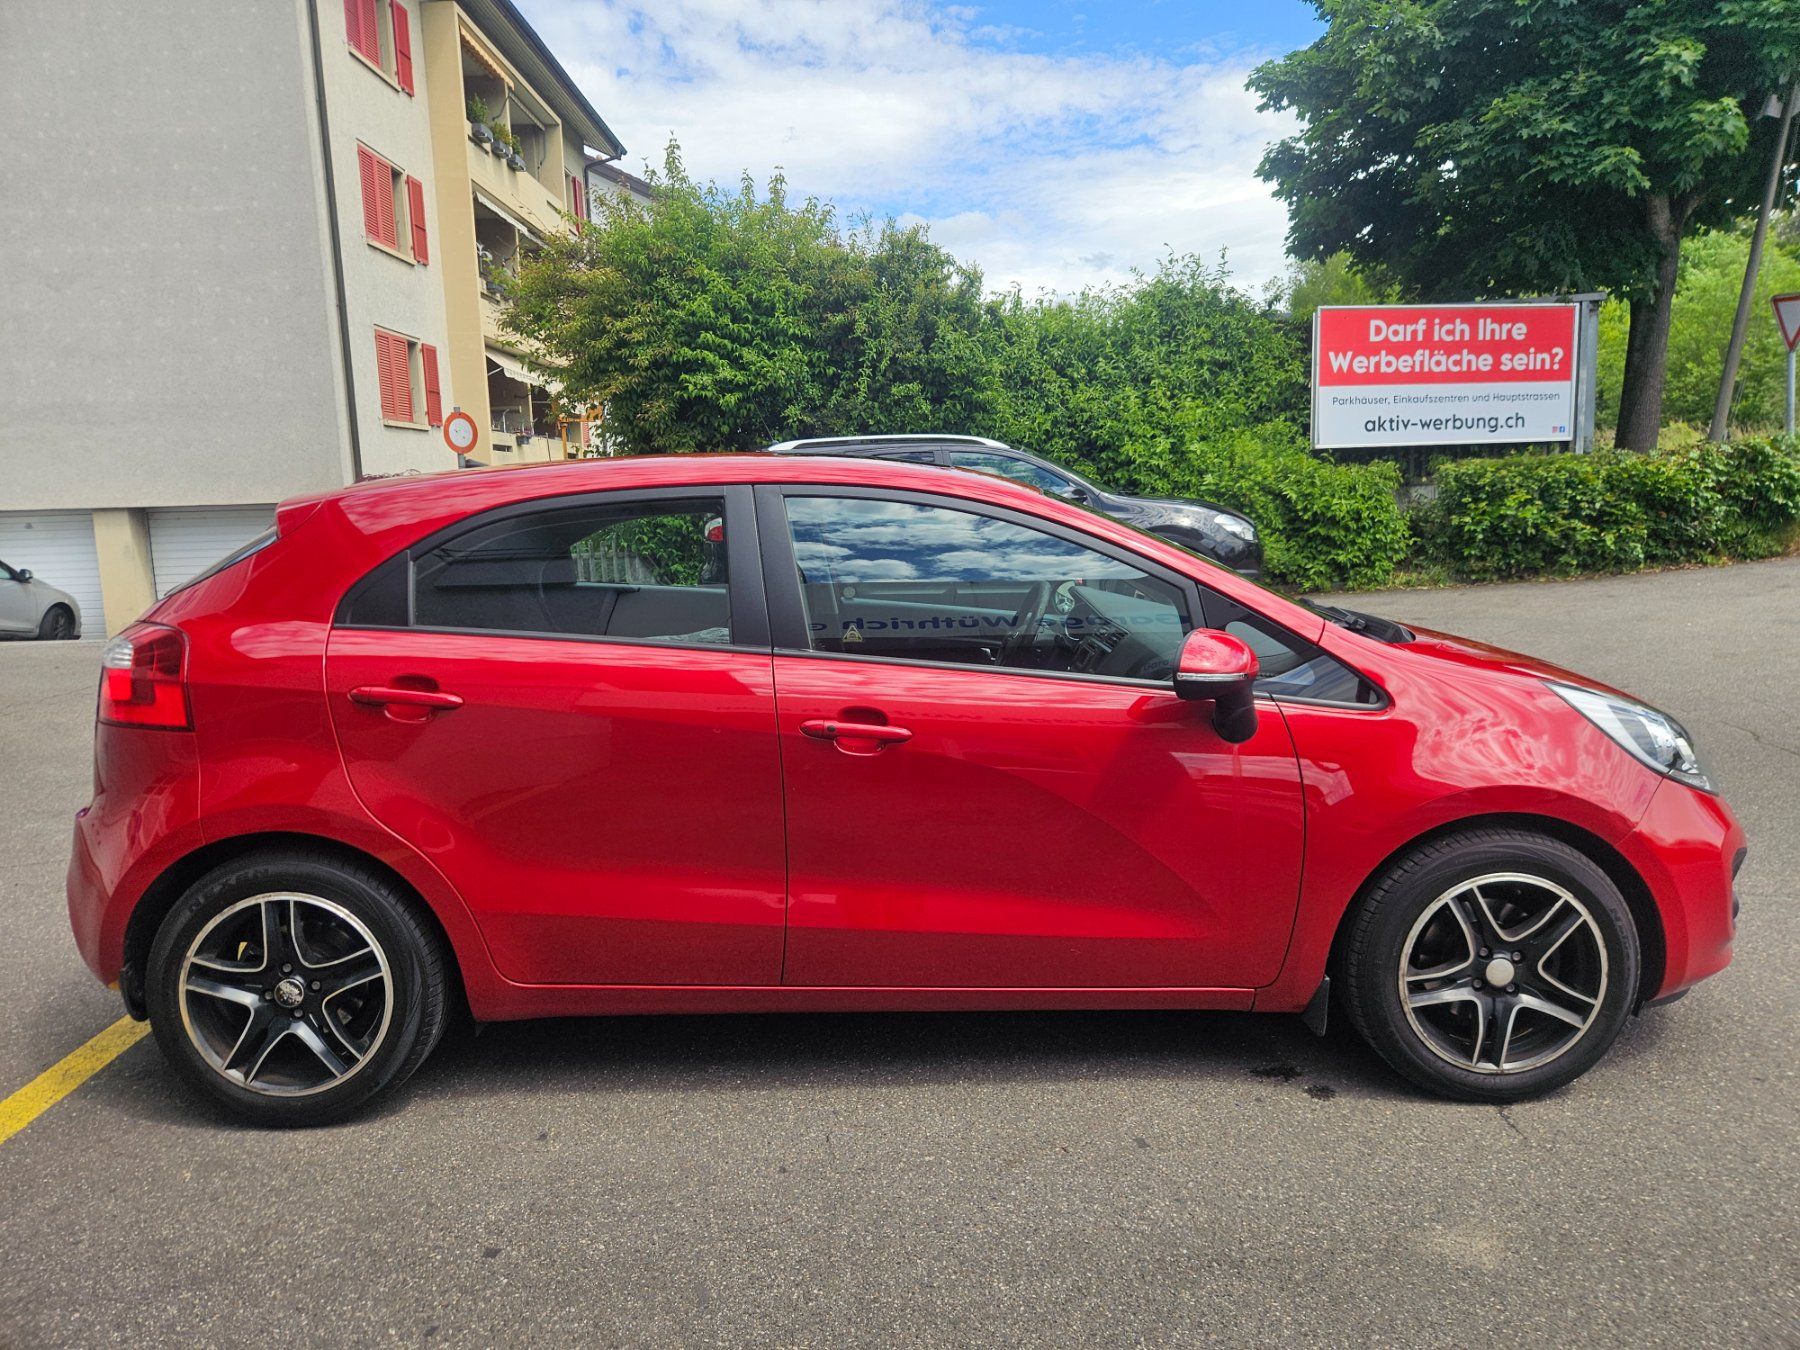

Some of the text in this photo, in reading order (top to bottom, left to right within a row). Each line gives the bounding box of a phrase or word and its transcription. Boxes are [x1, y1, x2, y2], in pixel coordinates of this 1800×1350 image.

[1369, 317, 1528, 342] Darf ich Ihre
[1328, 346, 1564, 374] Werbefläche sein?
[1393, 394, 1470, 404] Einkaufszentren
[1472, 393, 1490, 402] und
[1493, 392, 1560, 402] Hauptstrassen
[1364, 412, 1525, 433] aktiv-werbung.ch
